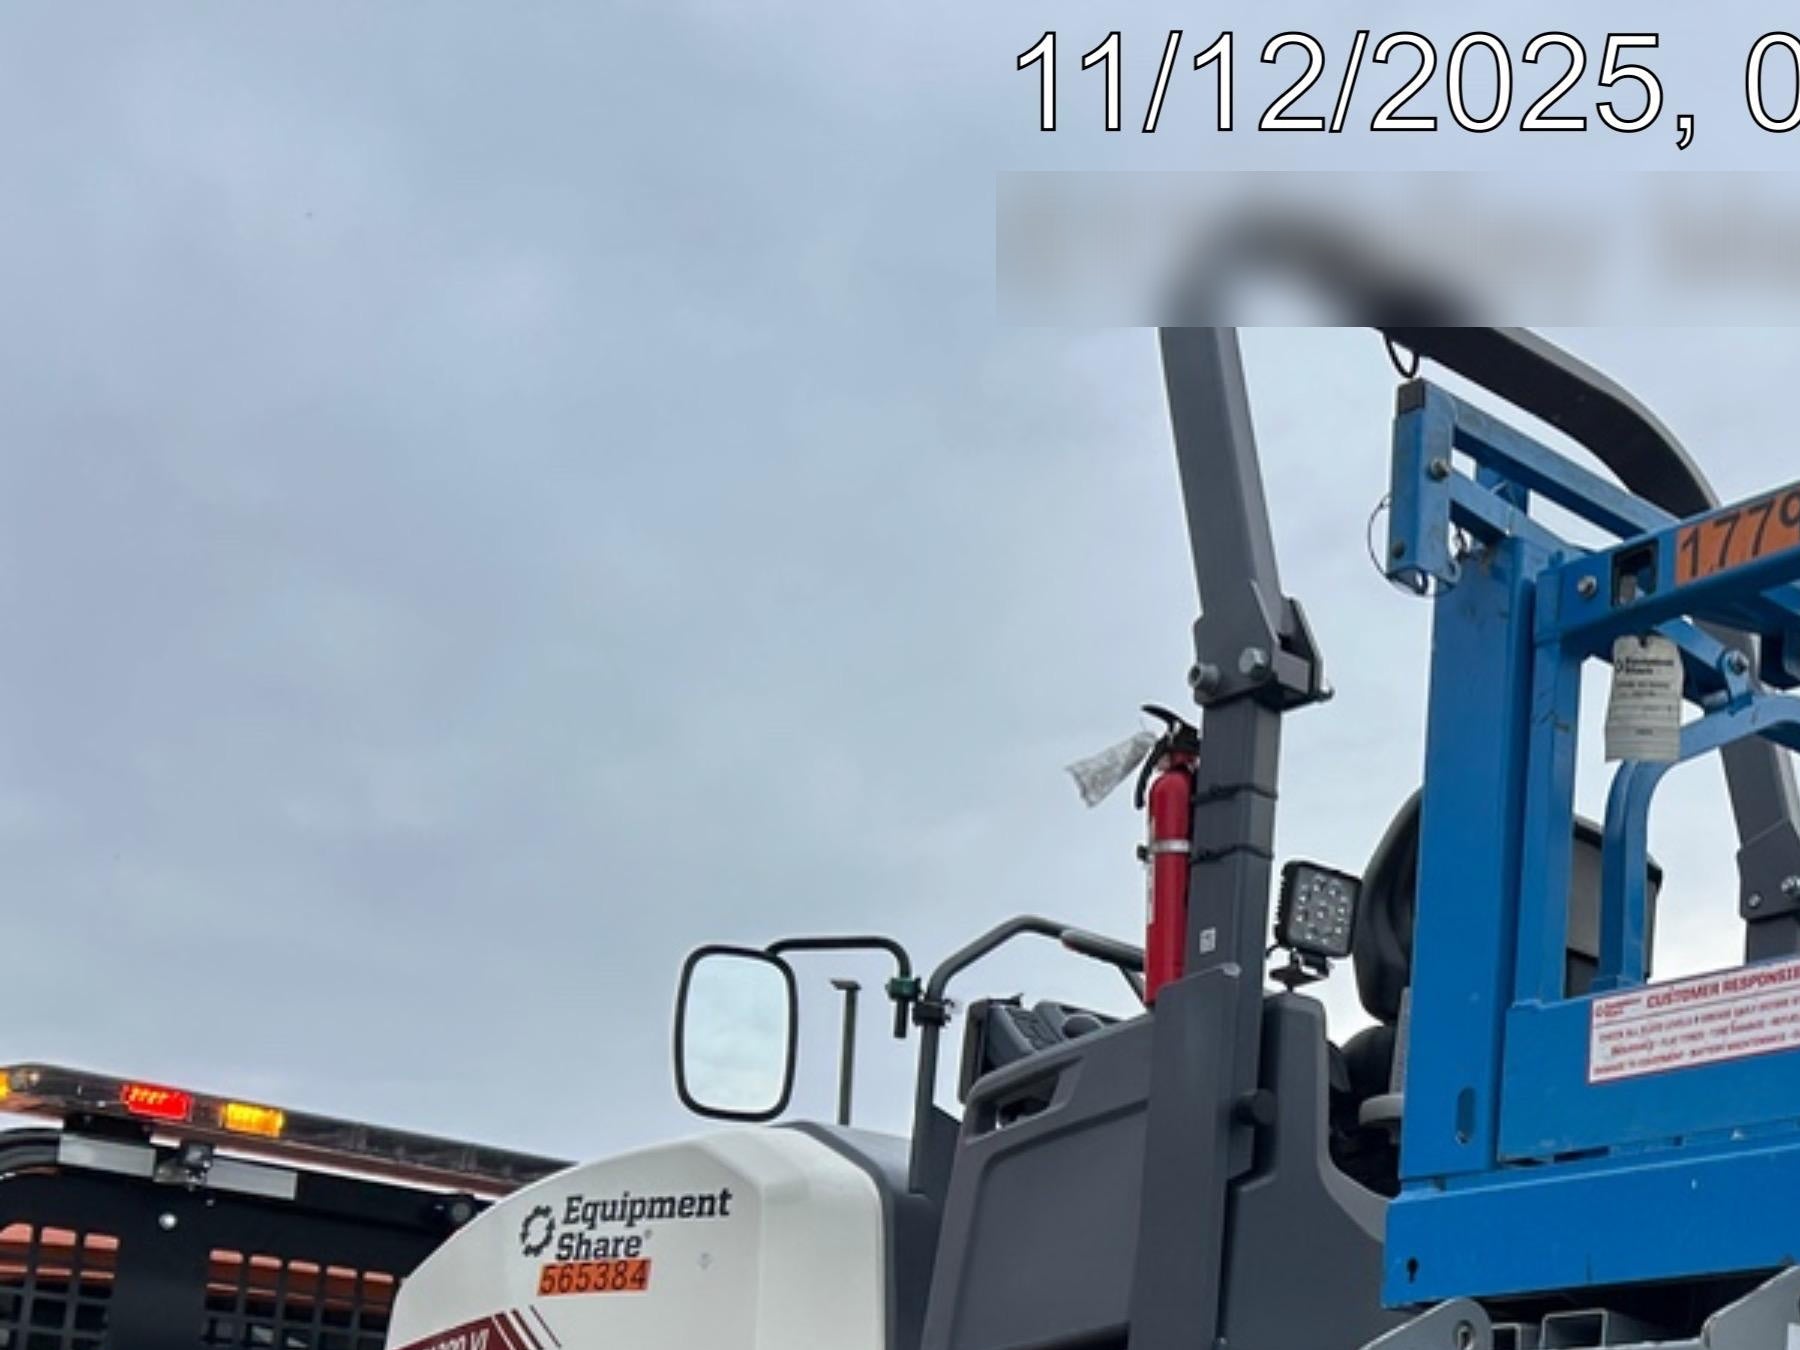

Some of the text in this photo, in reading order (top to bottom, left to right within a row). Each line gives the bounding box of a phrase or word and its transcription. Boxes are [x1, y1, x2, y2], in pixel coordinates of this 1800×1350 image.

[1646, 982, 1719, 1009] CUSTOMER
[563, 1188, 733, 1230] Equipment
[555, 1232, 642, 1262] Share
[540, 1260, 649, 1294] 565384
